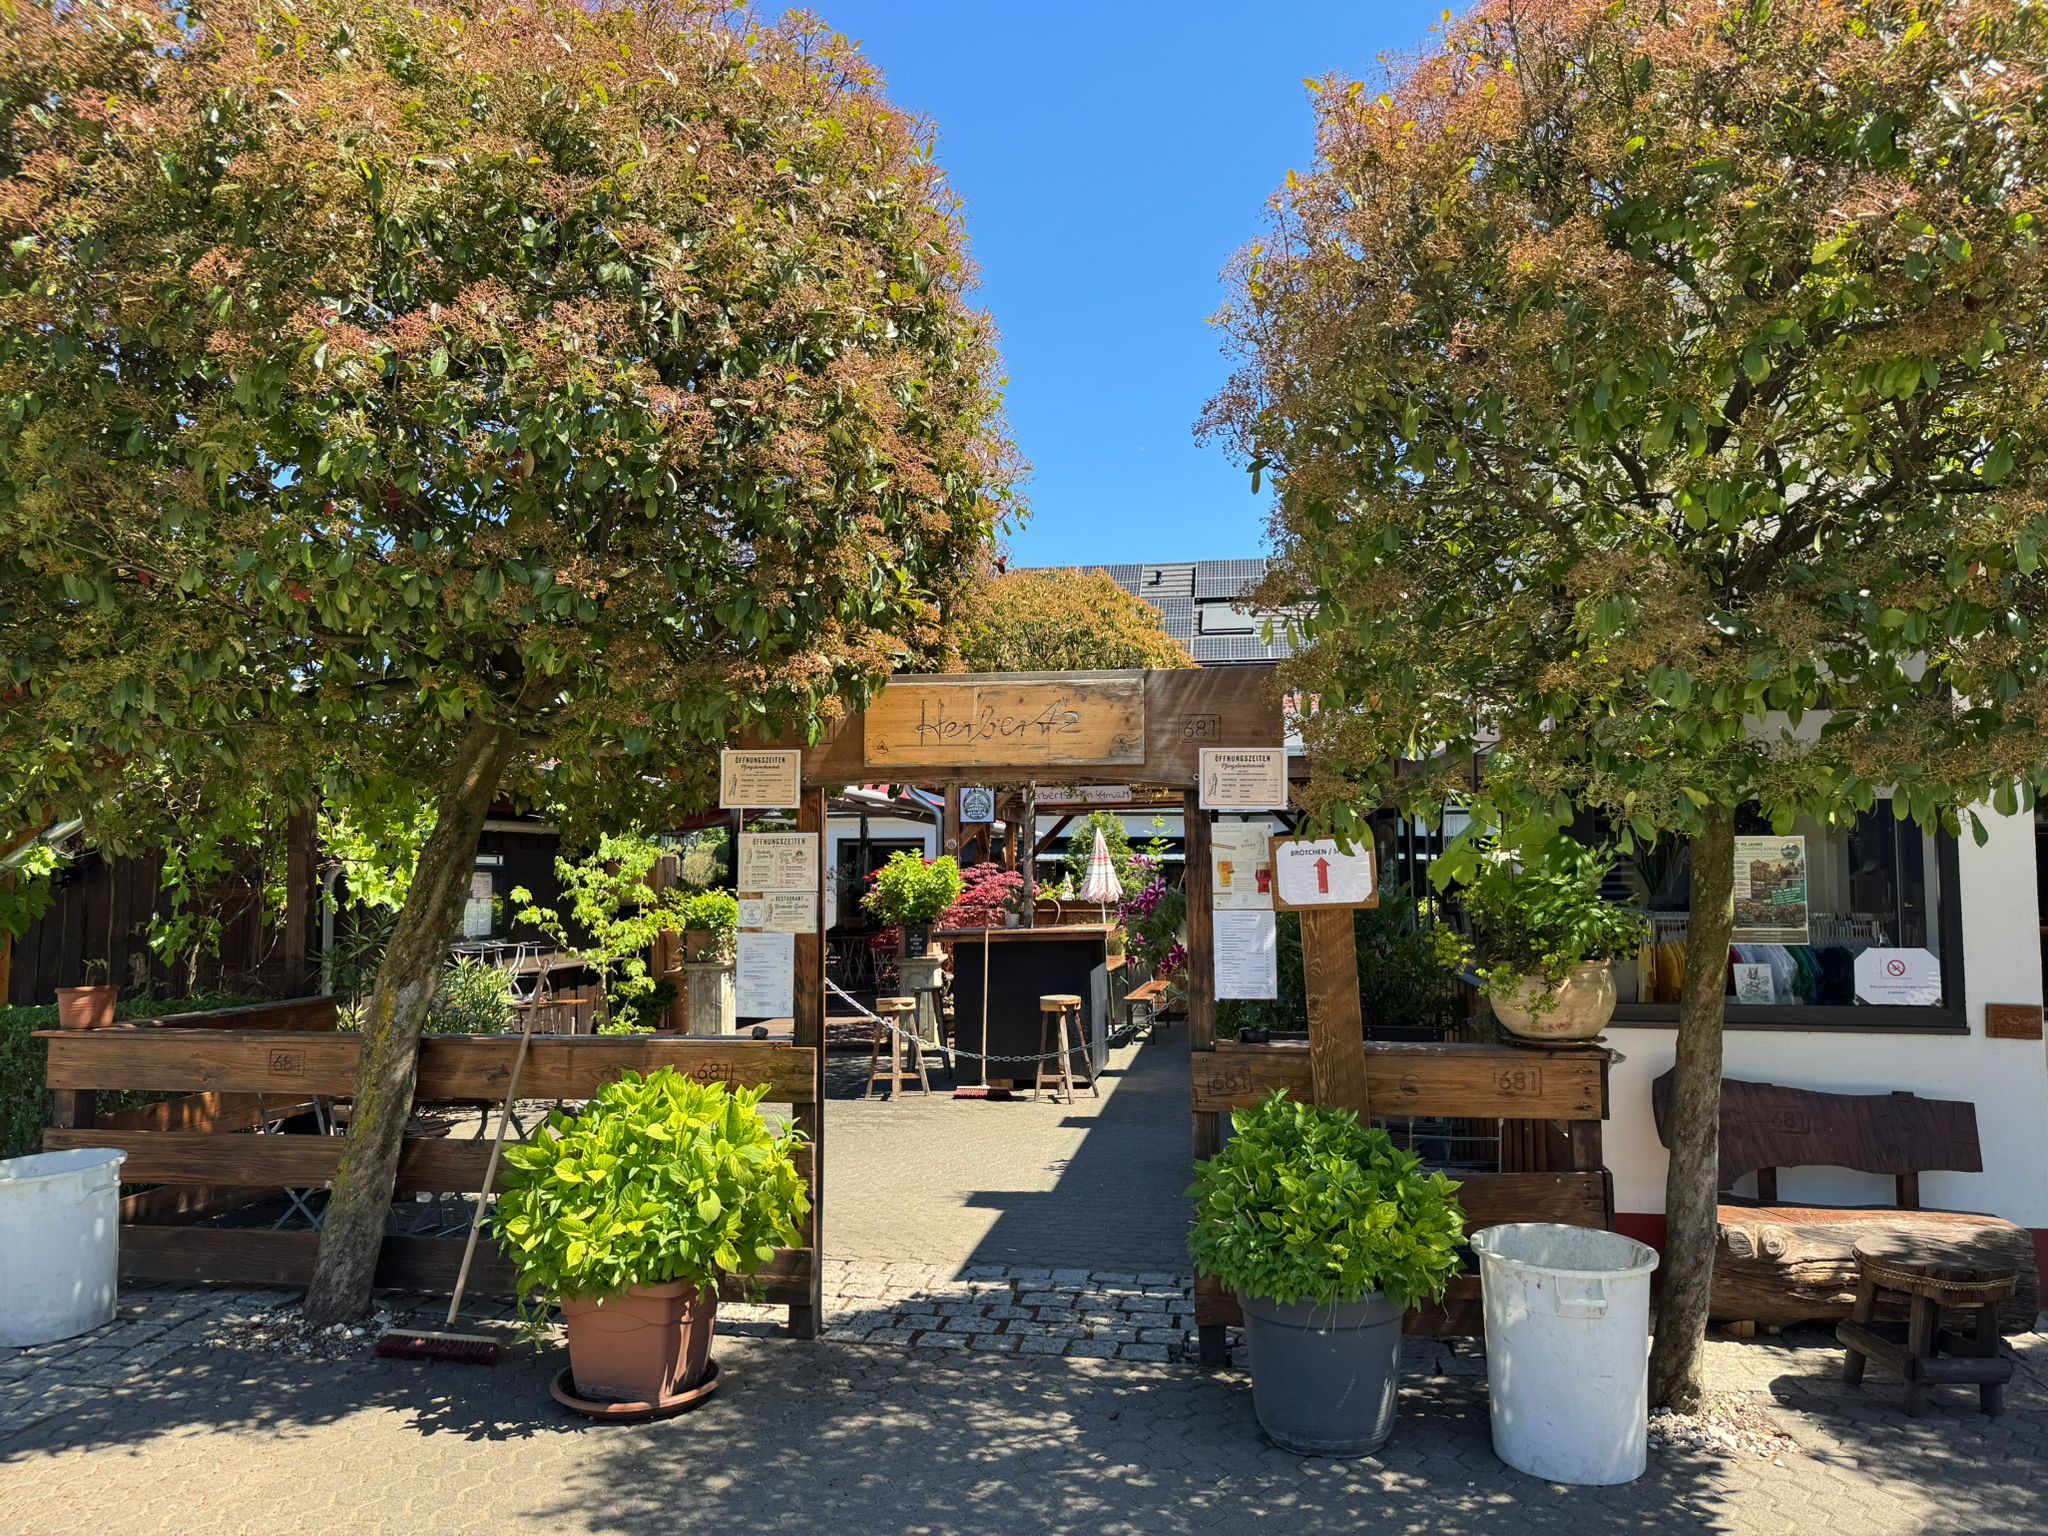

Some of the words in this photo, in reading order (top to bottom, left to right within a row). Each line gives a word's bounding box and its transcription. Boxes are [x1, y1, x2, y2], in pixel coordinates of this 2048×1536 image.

[916, 697, 1081, 747] Herbertz
[1183, 719, 1216, 738] 681
[735, 755, 786, 764] ÖFFNUNGSZEITEN
[1215, 753, 1271, 762] ÖFFNUNGSZEITEN
[752, 837, 806, 846] ÖFFNUNGSZEITEN
[1290, 848, 1327, 857] BRÖTCHEN
[697, 1063, 728, 1081] 681
[1499, 1070, 1536, 1091] 681
[1772, 1110, 1805, 1129] 681
